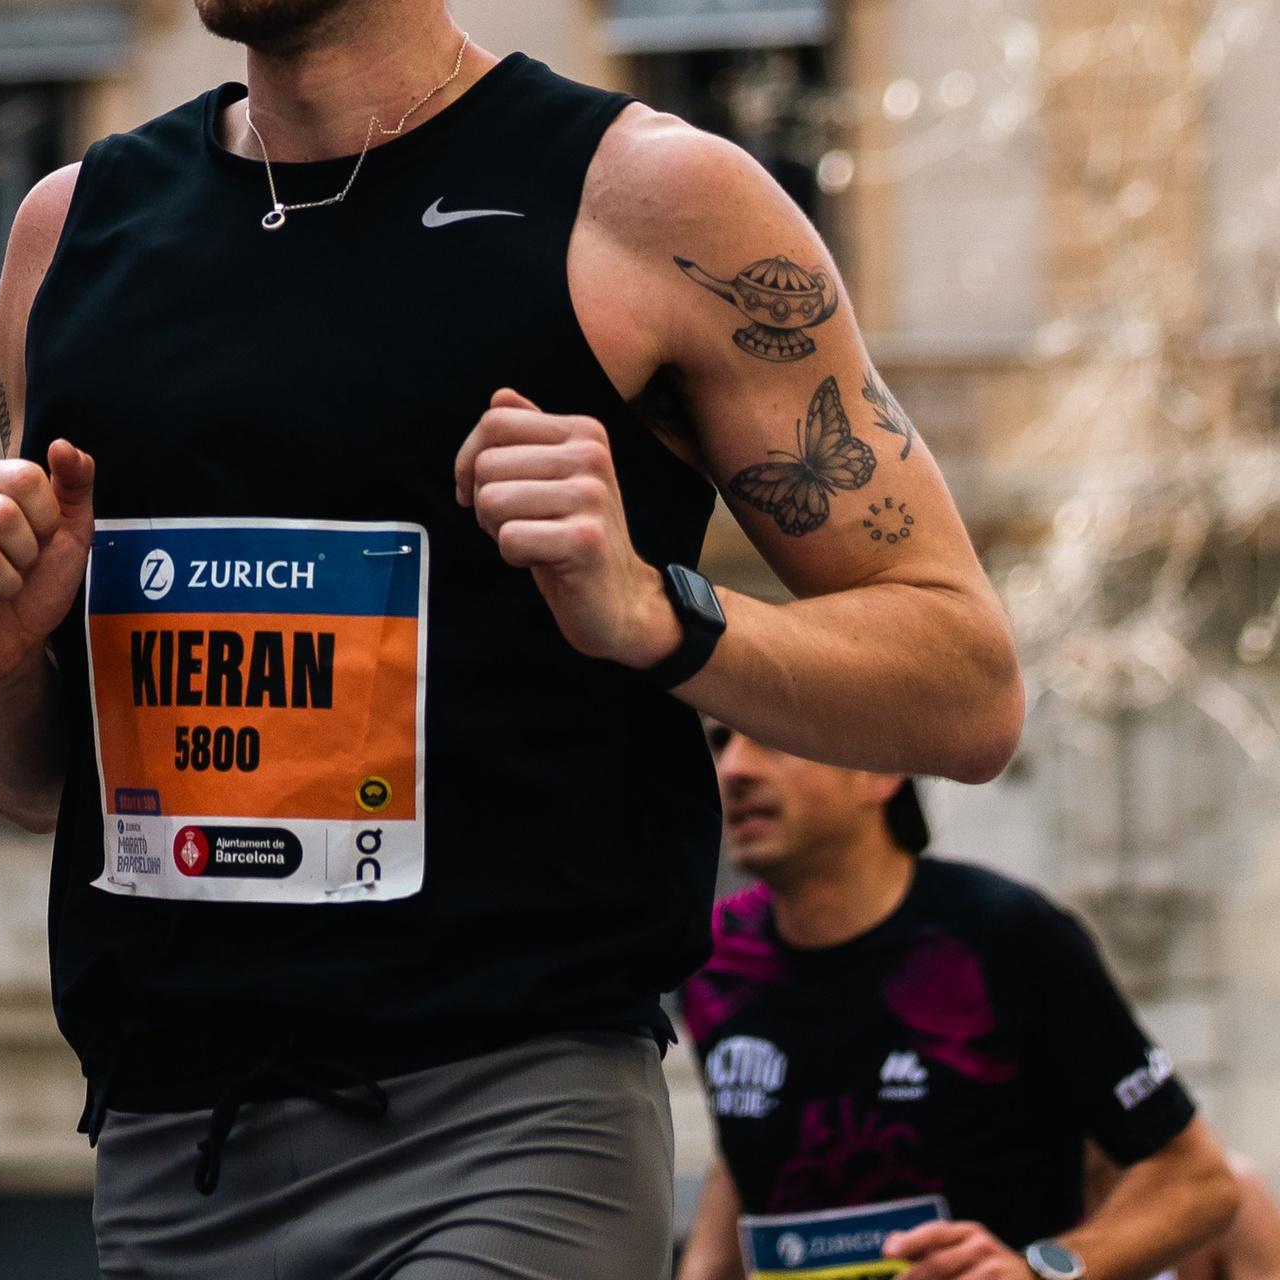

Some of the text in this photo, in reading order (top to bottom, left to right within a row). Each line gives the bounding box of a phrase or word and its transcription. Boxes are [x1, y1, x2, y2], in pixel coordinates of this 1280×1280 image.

[862, 497, 914, 545] FEEL GOOD
[187, 560, 315, 589] ZURICH
[131, 630, 335, 709] KIERAN
[174, 726, 260, 773] 5800
[215, 850, 285, 865] Barcelona
[216, 837, 285, 849] Ajuntament de
[116, 855, 161, 874] BARCELONA
